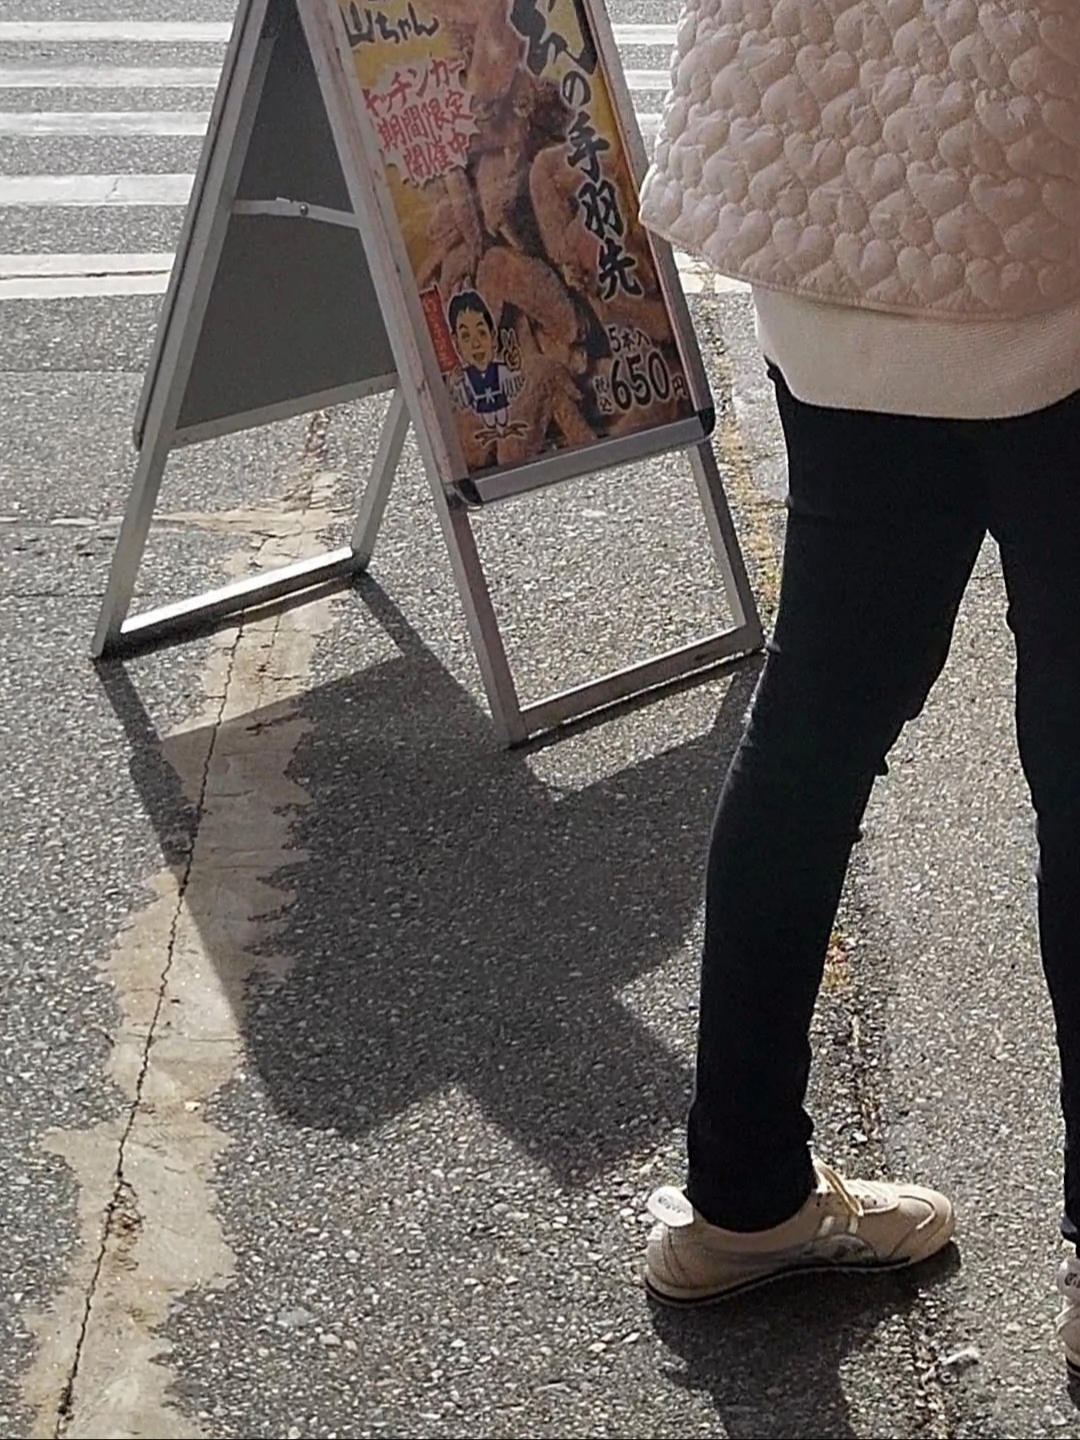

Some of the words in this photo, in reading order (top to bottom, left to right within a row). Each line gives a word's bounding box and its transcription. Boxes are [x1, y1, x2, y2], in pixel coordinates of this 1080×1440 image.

[341, 0, 440, 49] 山ちゃん
[376, 88, 475, 158] 期間限定
[402, 127, 471, 183] 開催中
[610, 350, 688, 411] 650円
